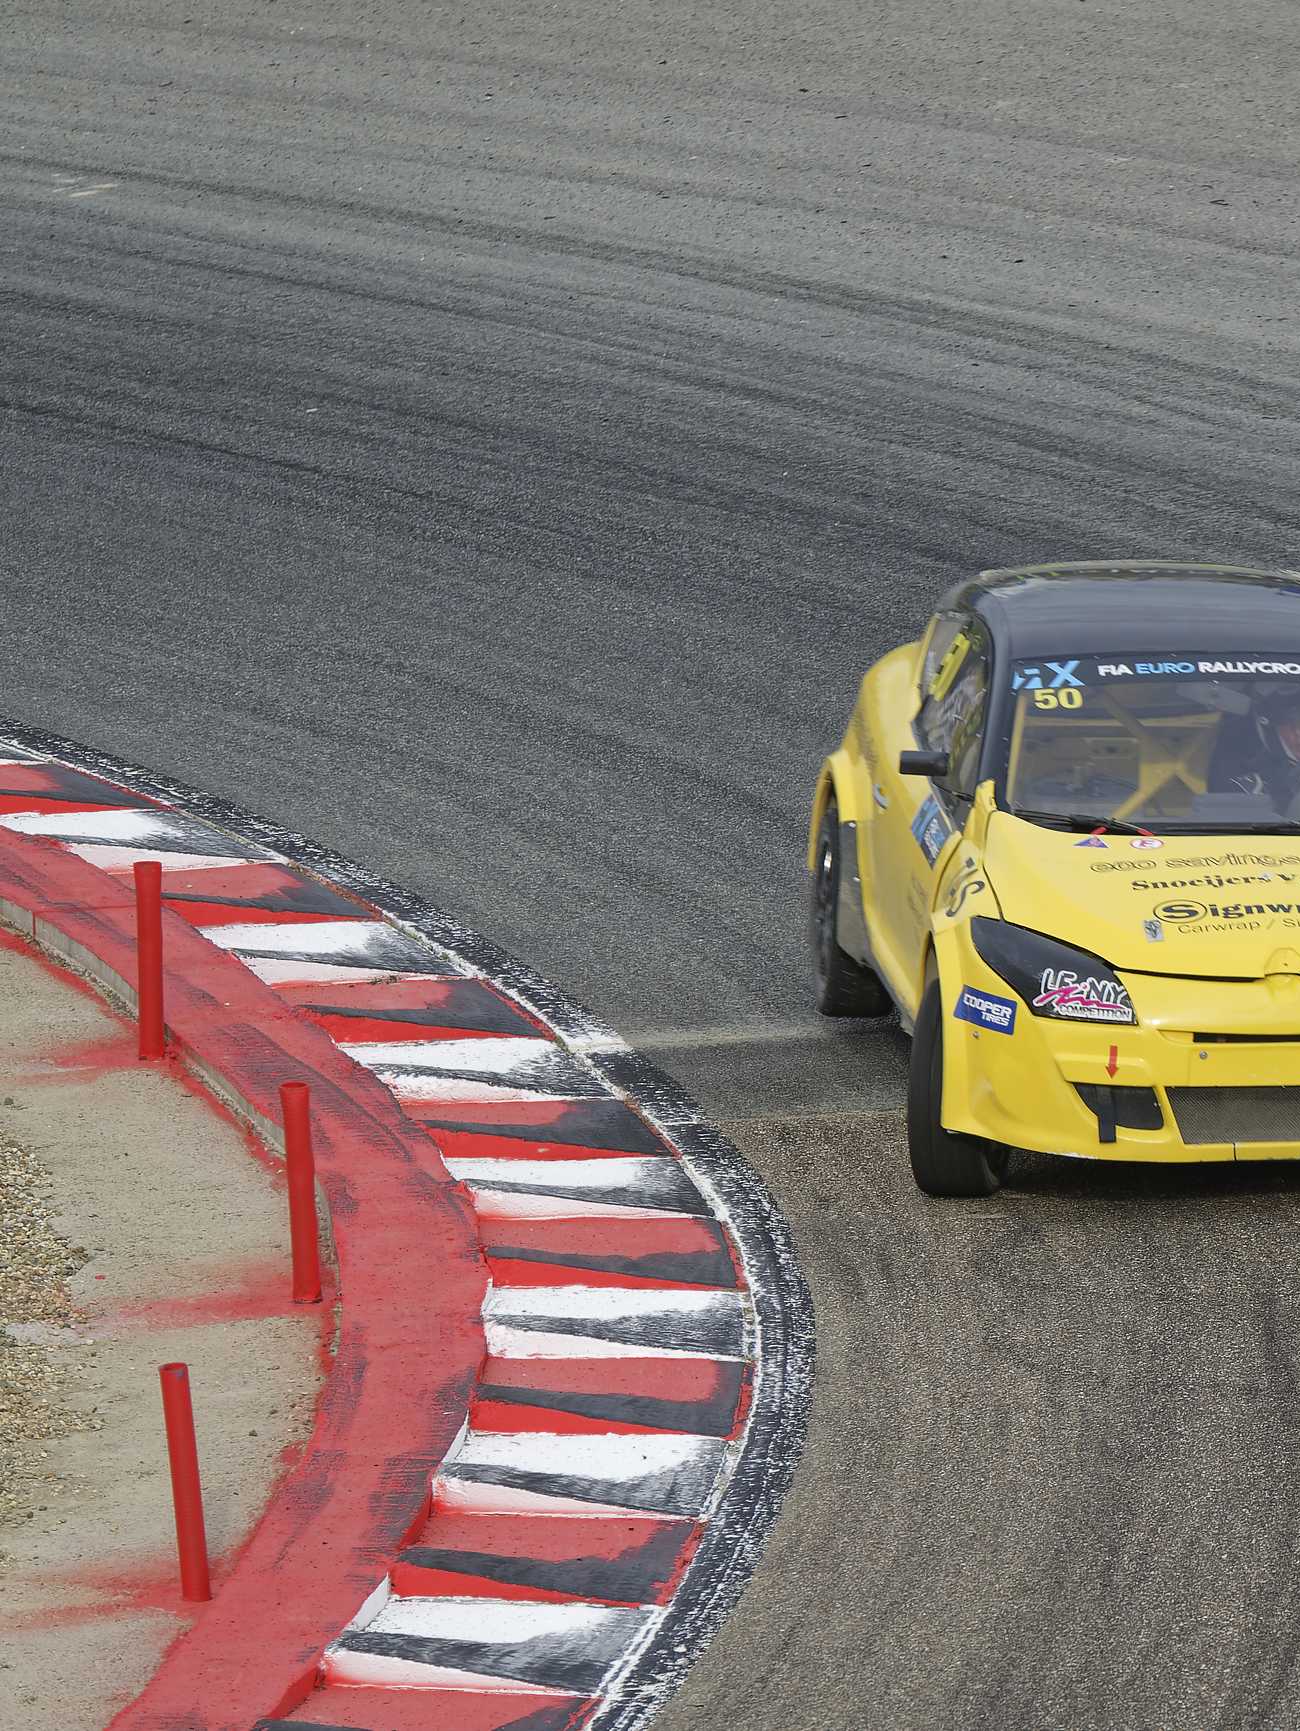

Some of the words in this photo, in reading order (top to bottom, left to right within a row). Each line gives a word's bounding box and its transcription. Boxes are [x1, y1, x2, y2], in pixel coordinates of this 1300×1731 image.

[1097, 663, 1134, 677] FIA
[1135, 662, 1196, 675] EURO
[1033, 687, 1084, 710] 50
[1130, 875, 1272, 890] Snoeijers
[1177, 919, 1262, 934] Carwrap
[963, 993, 1013, 1018] COOPER
[981, 1011, 1010, 1027] TIRES
